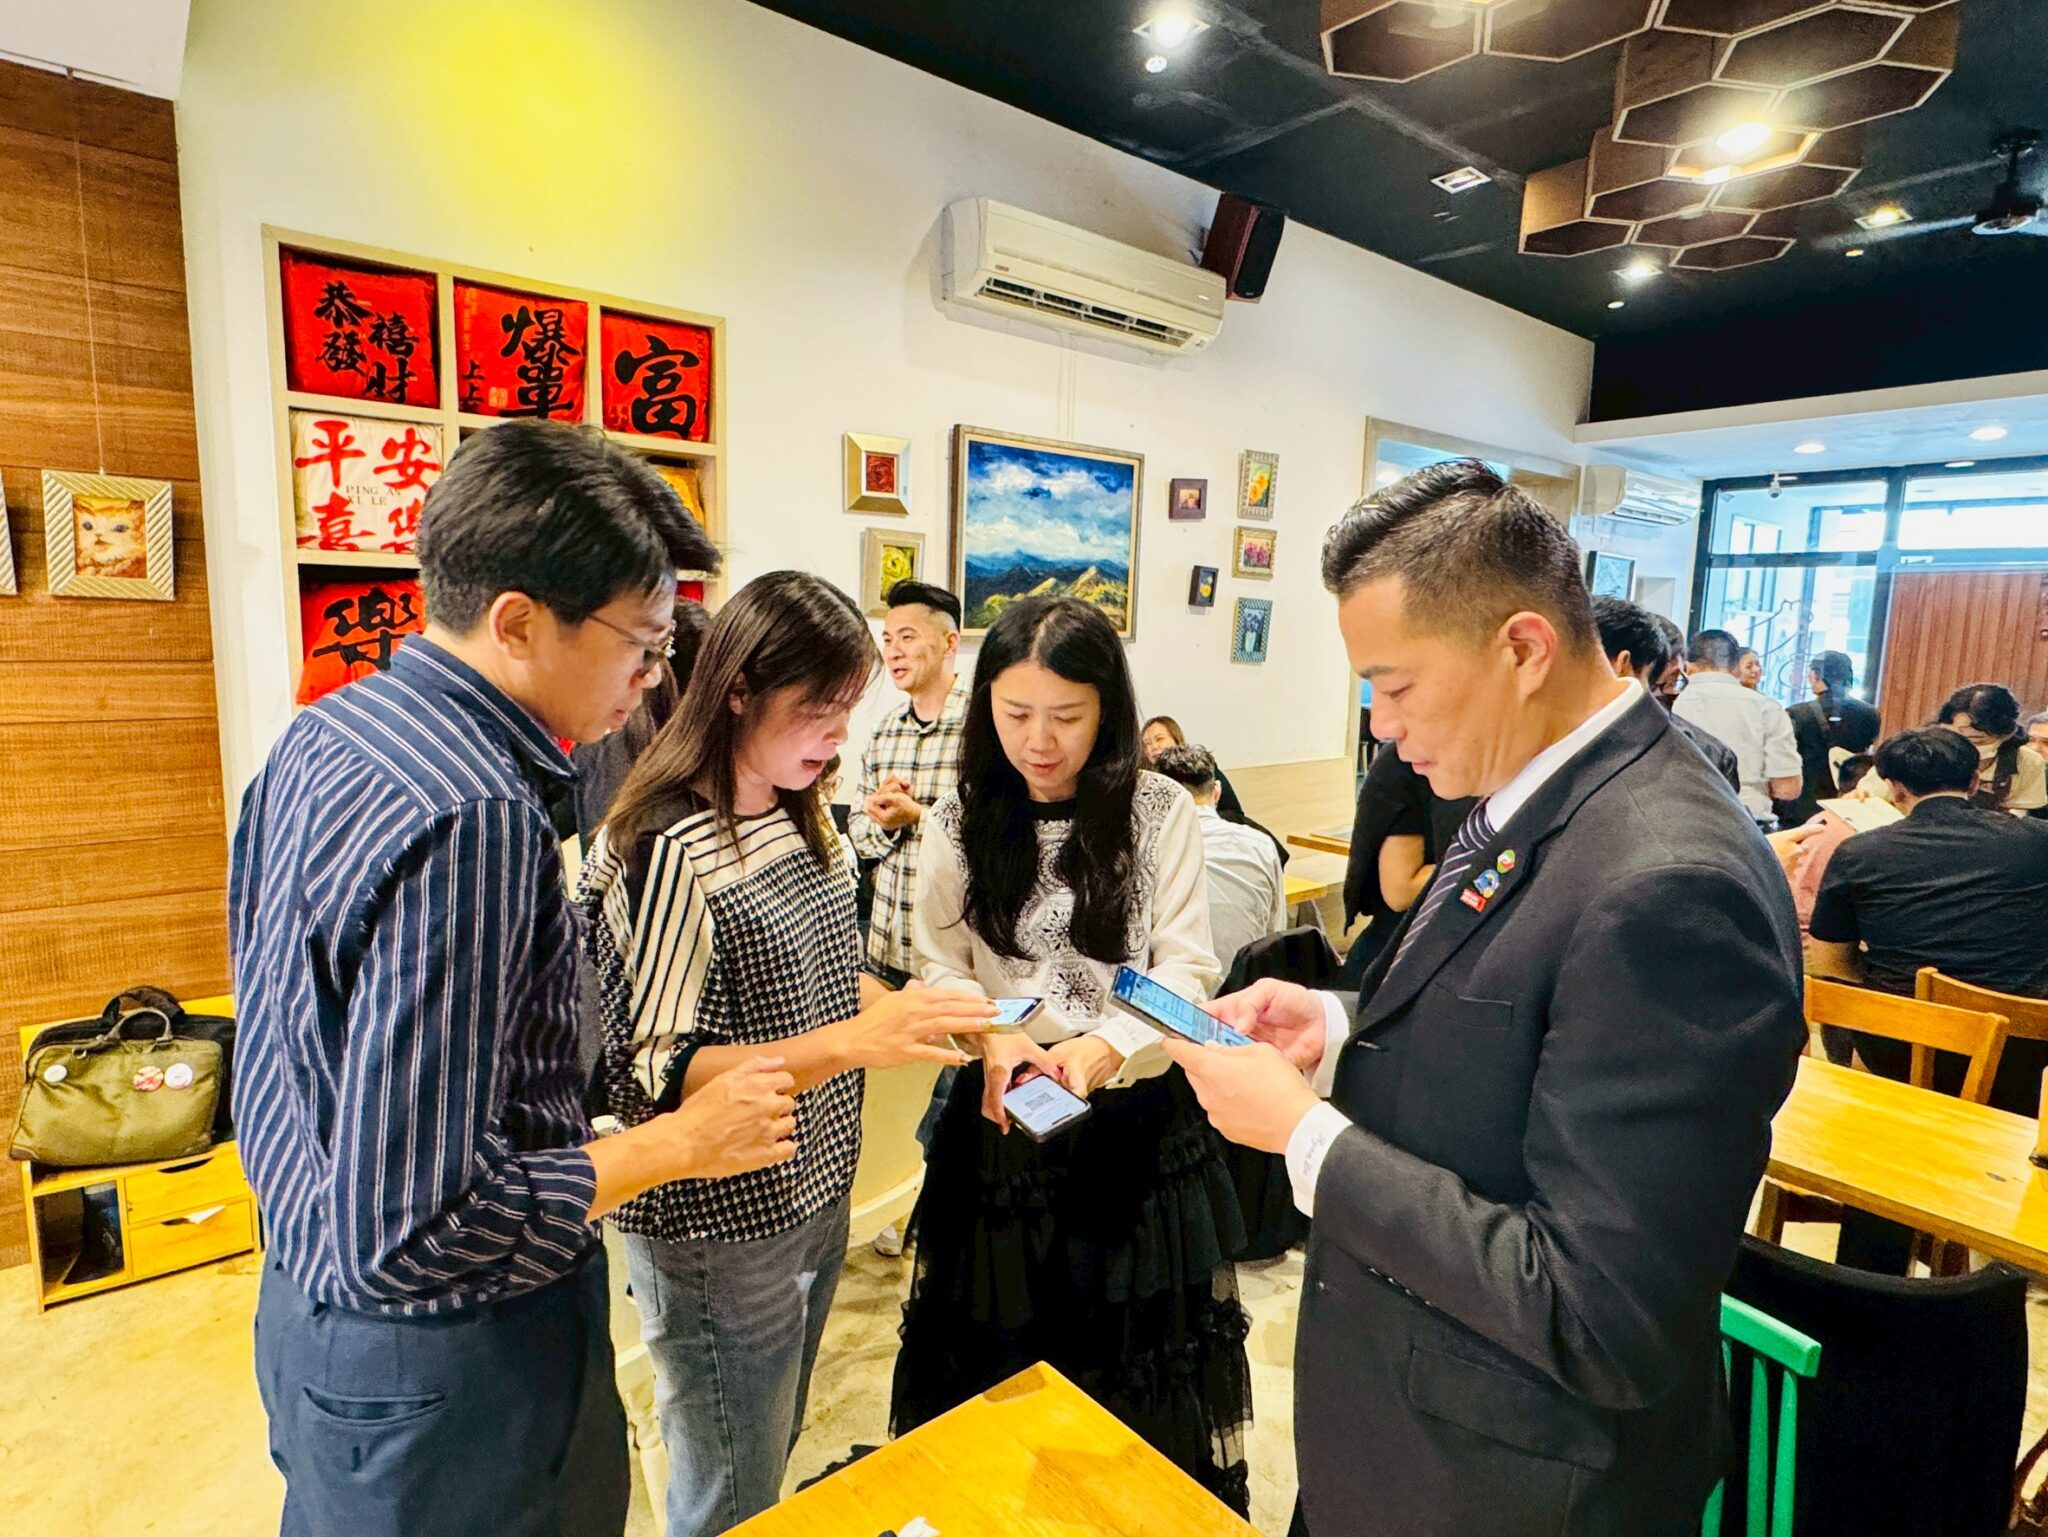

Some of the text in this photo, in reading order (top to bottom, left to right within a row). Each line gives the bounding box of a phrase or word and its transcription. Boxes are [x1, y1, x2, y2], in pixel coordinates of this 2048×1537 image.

[614, 334, 701, 440] 富
[295, 420, 442, 492] 平安
[346, 485, 378, 496] PING
